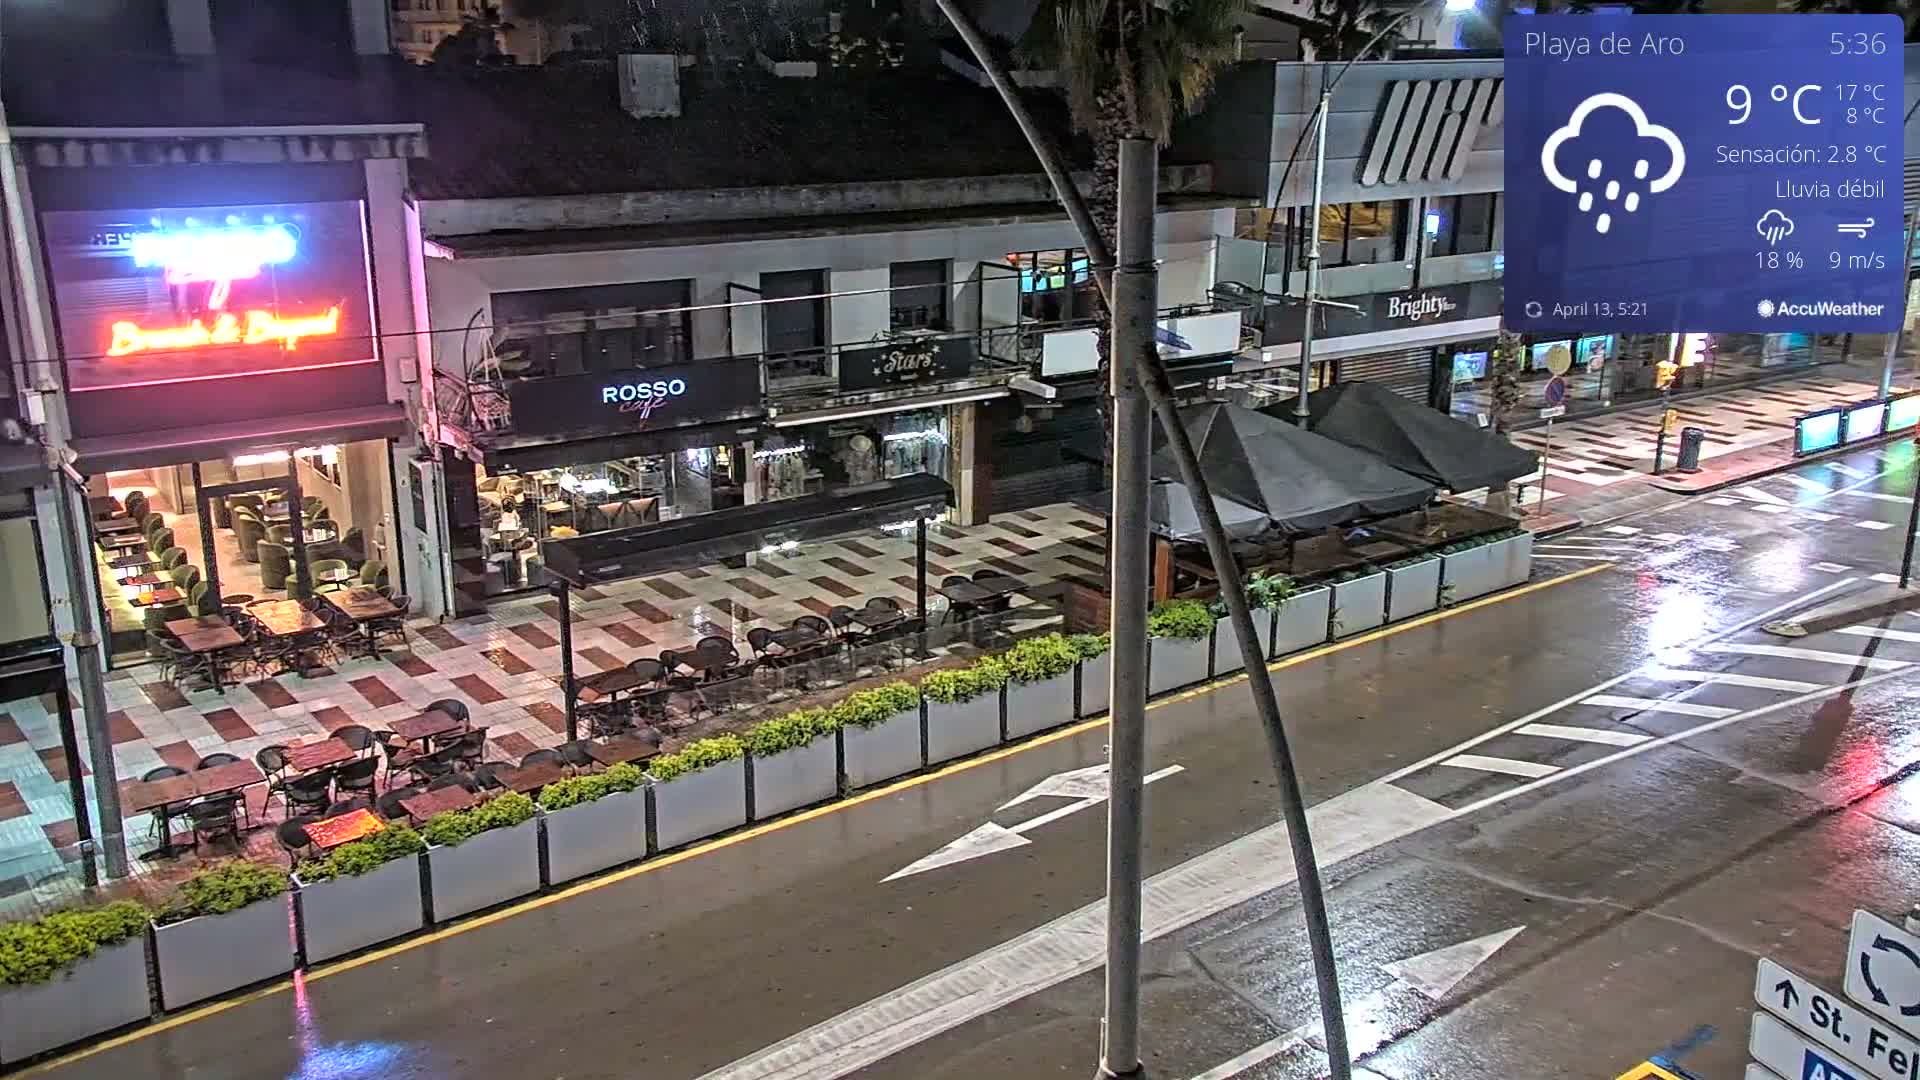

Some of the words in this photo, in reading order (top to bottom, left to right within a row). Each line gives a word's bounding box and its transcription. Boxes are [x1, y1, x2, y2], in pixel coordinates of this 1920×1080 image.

[1387, 293, 1442, 321] Brighty
[883, 351, 932, 373] Stars
[602, 379, 686, 403] ROSSO
[1809, 995, 1851, 1044] St.
